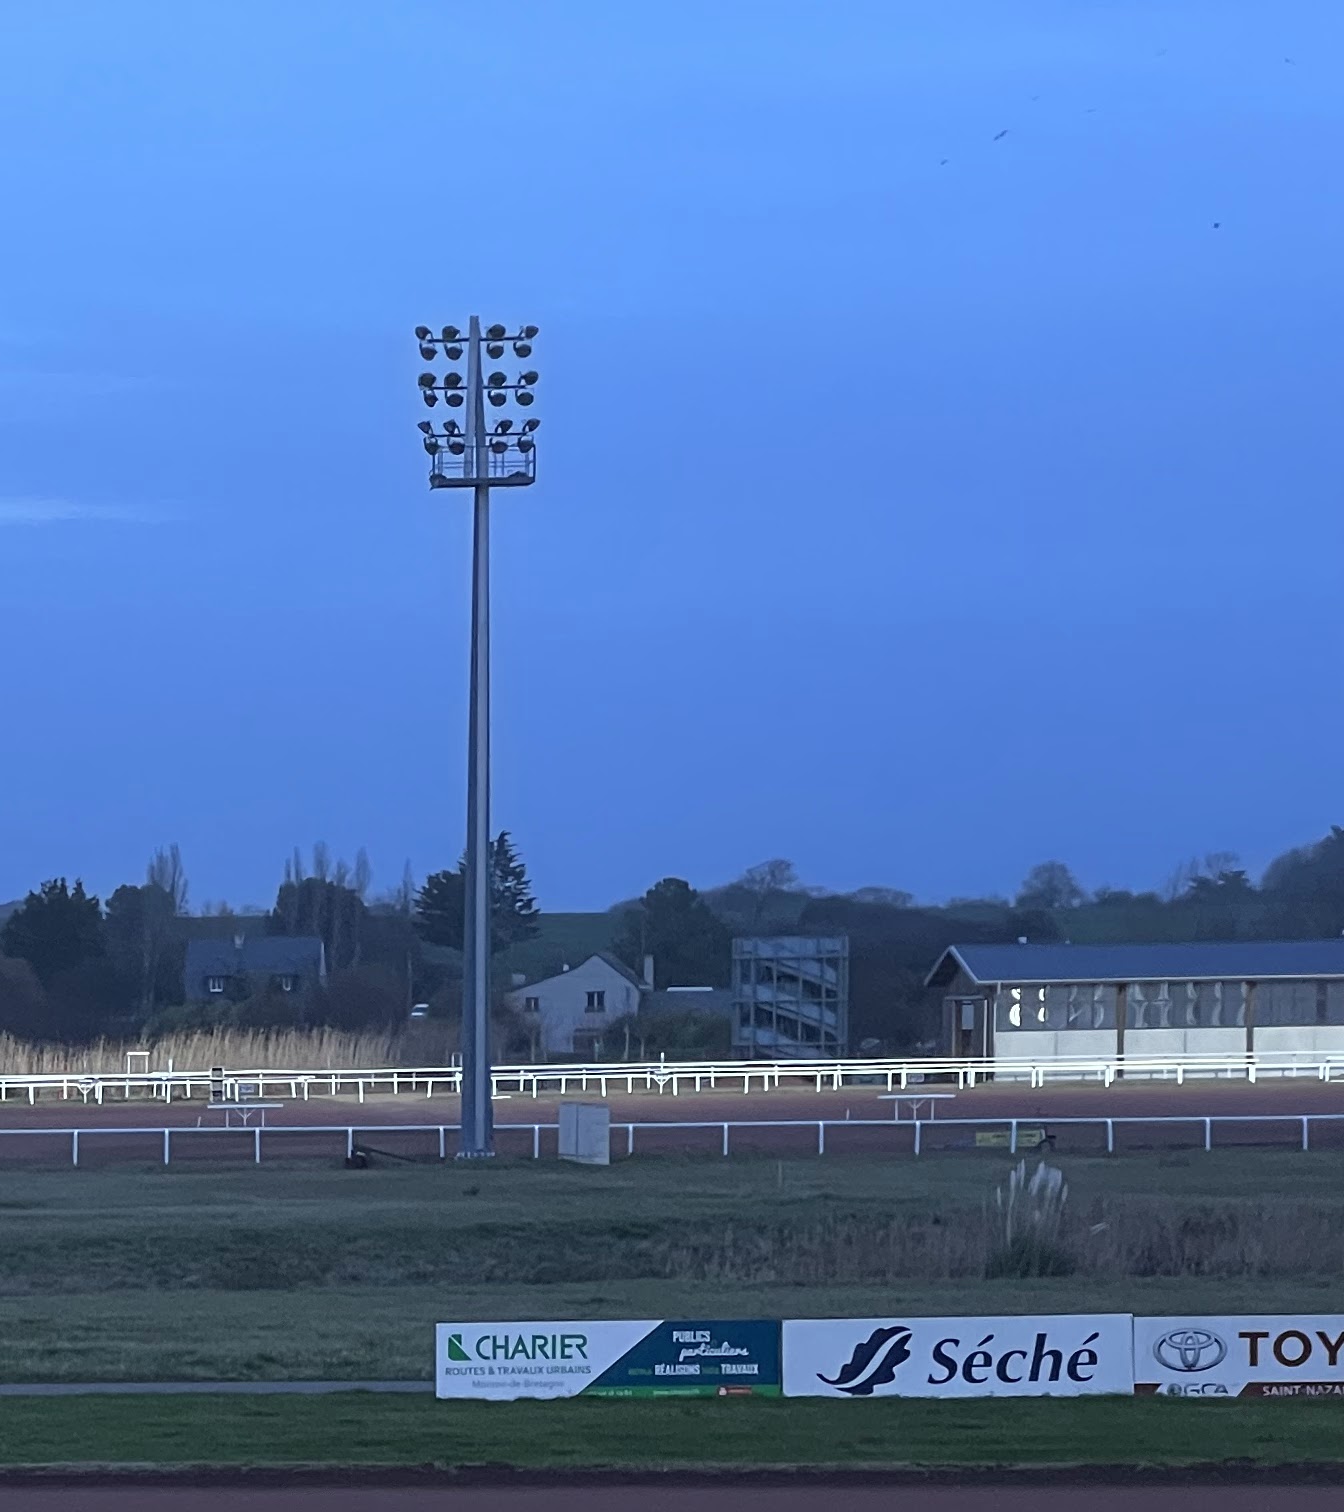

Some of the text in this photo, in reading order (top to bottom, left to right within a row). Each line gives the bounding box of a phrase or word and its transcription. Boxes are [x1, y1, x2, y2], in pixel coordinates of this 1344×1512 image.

[673, 1331, 710, 1342] PUBLICS
[475, 1334, 588, 1360] CHARIER
[678, 1341, 749, 1362] particuliers
[1238, 1330, 1344, 1367] TOY
[927, 1332, 1100, 1384] Séché
[445, 1365, 591, 1376] ROUTES & TRAVAUX URBAINS
[654, 1363, 700, 1375] RÉALISONS
[721, 1364, 759, 1375] TRAVAUX
[1262, 1385, 1302, 1396] SAINT
